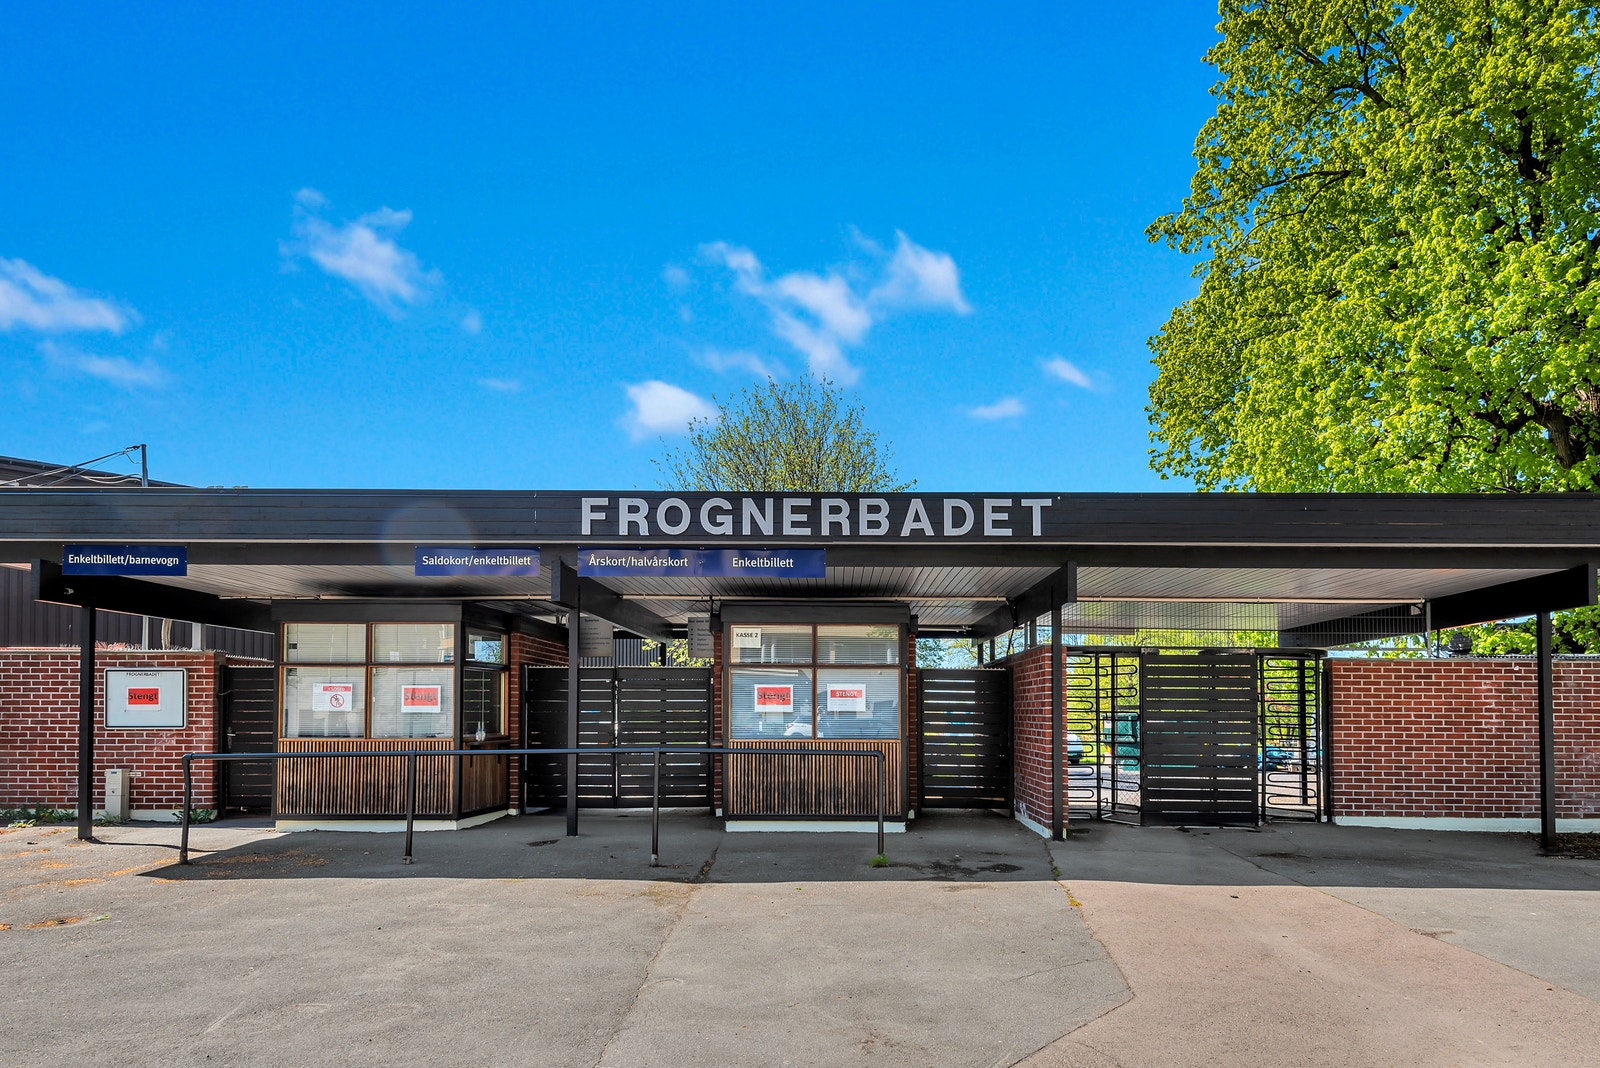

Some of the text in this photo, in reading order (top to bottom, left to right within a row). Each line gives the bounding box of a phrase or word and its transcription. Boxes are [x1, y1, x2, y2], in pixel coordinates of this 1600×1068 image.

[581, 497, 1053, 537] FROGNERBADET
[68, 554, 179, 566] Enkeltbillett/barnevogn
[422, 555, 531, 566] Saldokort/enkeltbillett
[588, 554, 688, 567] Årskort/halvårskort
[732, 557, 794, 568] Enkeltbillett
[128, 692, 158, 701] Stengt
[404, 691, 437, 702] Stengt
